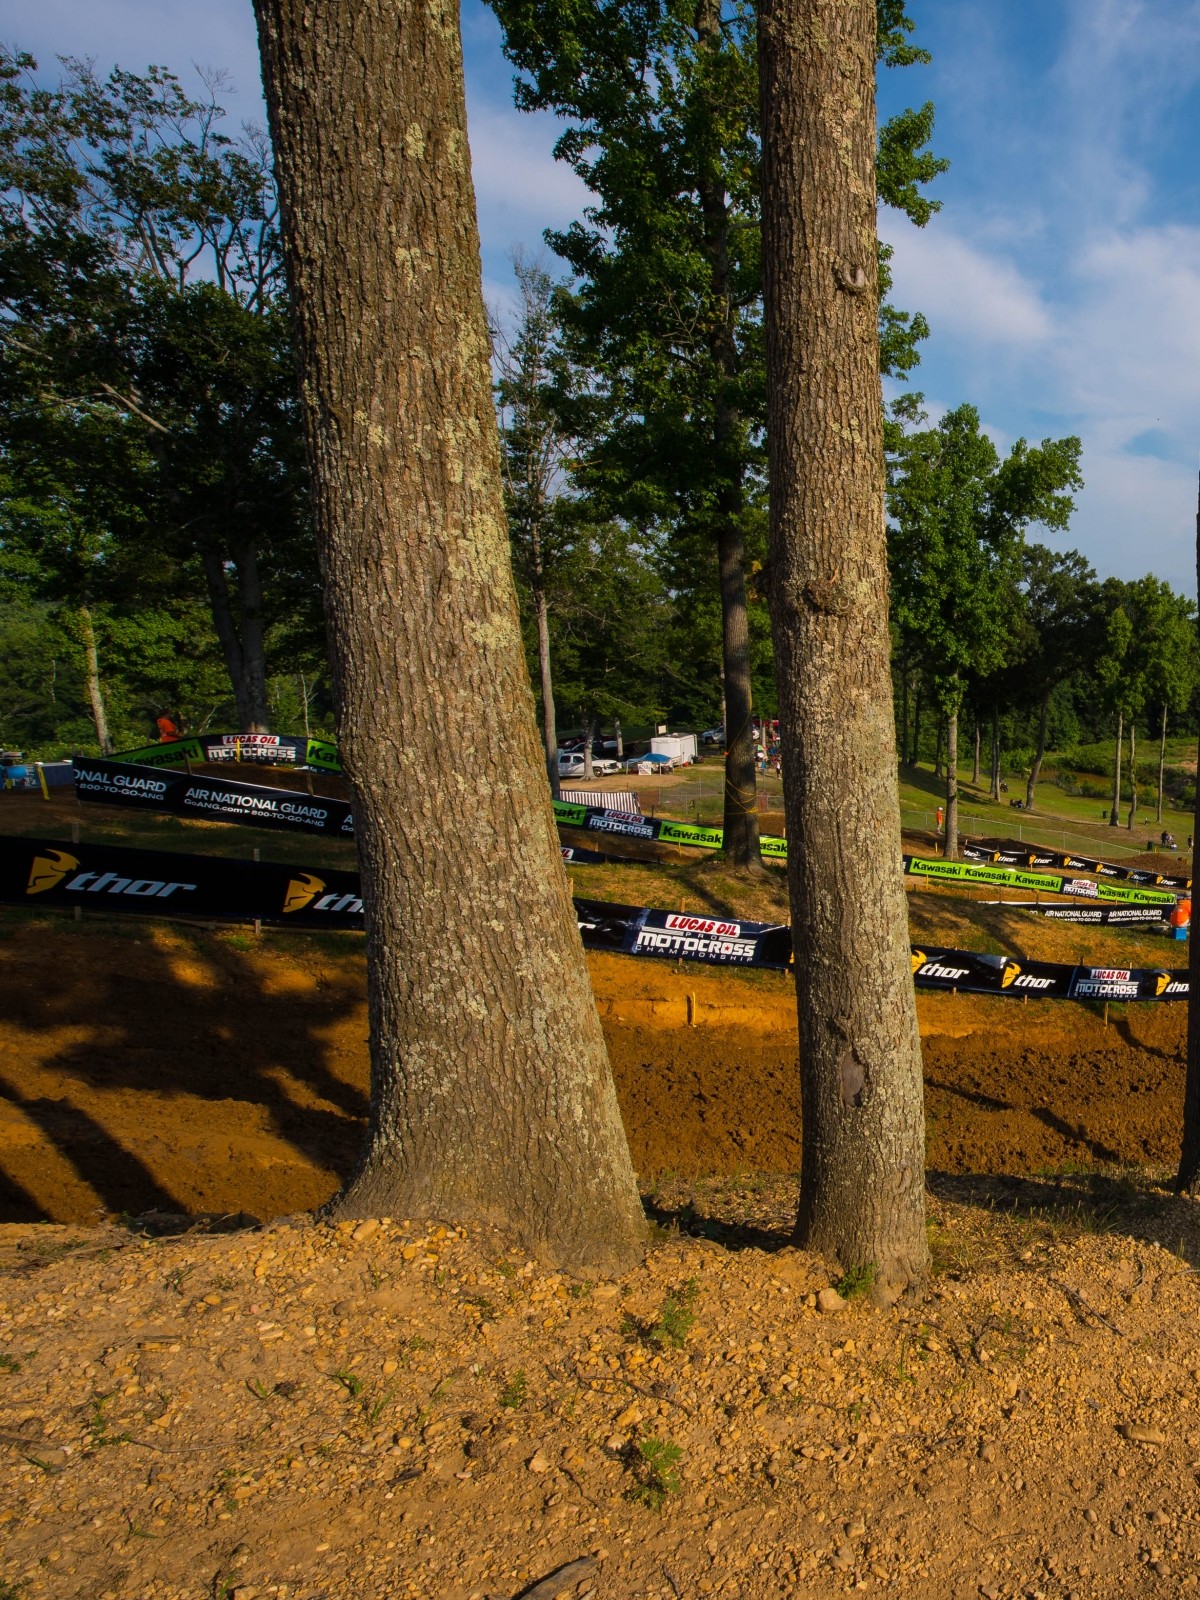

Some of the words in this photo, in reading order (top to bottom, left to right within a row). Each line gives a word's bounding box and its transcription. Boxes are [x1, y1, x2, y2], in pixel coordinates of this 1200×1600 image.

[226, 735, 258, 745] LUCAS
[260, 735, 278, 745] OIL
[79, 782, 165, 801] 800-TO-GO-ANG
[112, 774, 167, 794] GUARD
[185, 787, 209, 802] AIR
[210, 790, 279, 812] NATIONAL
[280, 801, 328, 820] GUARD
[184, 798, 244, 815] GoANG.com
[251, 808, 326, 828] 800-TO-GO-ANG
[606, 811, 630, 822] LUCAS
[631, 815, 645, 825] OIL
[589, 817, 654, 837] MOTOCROSS
[664, 827, 722, 844] Kawasak
[913, 860, 961, 876] Kawasaki
[964, 868, 1011, 882] Kawasaki
[1015, 874, 1060, 889] Kawasaki
[65, 871, 198, 899] thor
[1063, 886, 1099, 896] MOTOCROS
[1133, 891, 1175, 904] Kawasaki
[1141, 909, 1162, 917] GUARD
[668, 915, 714, 934] LUCAS
[715, 923, 738, 937] OIL
[636, 931, 756, 958] MOTOCROSS
[684, 931, 719, 942] PRO
[635, 944, 753, 963] CHAMPIONSHIP
[918, 962, 970, 980] thor
[1091, 969, 1114, 980] LUCAS
[1115, 970, 1129, 981] OIL
[1014, 974, 1056, 989] thor
[1075, 982, 1138, 996] MOTOCROSS
[1165, 981, 1190, 993] tho
